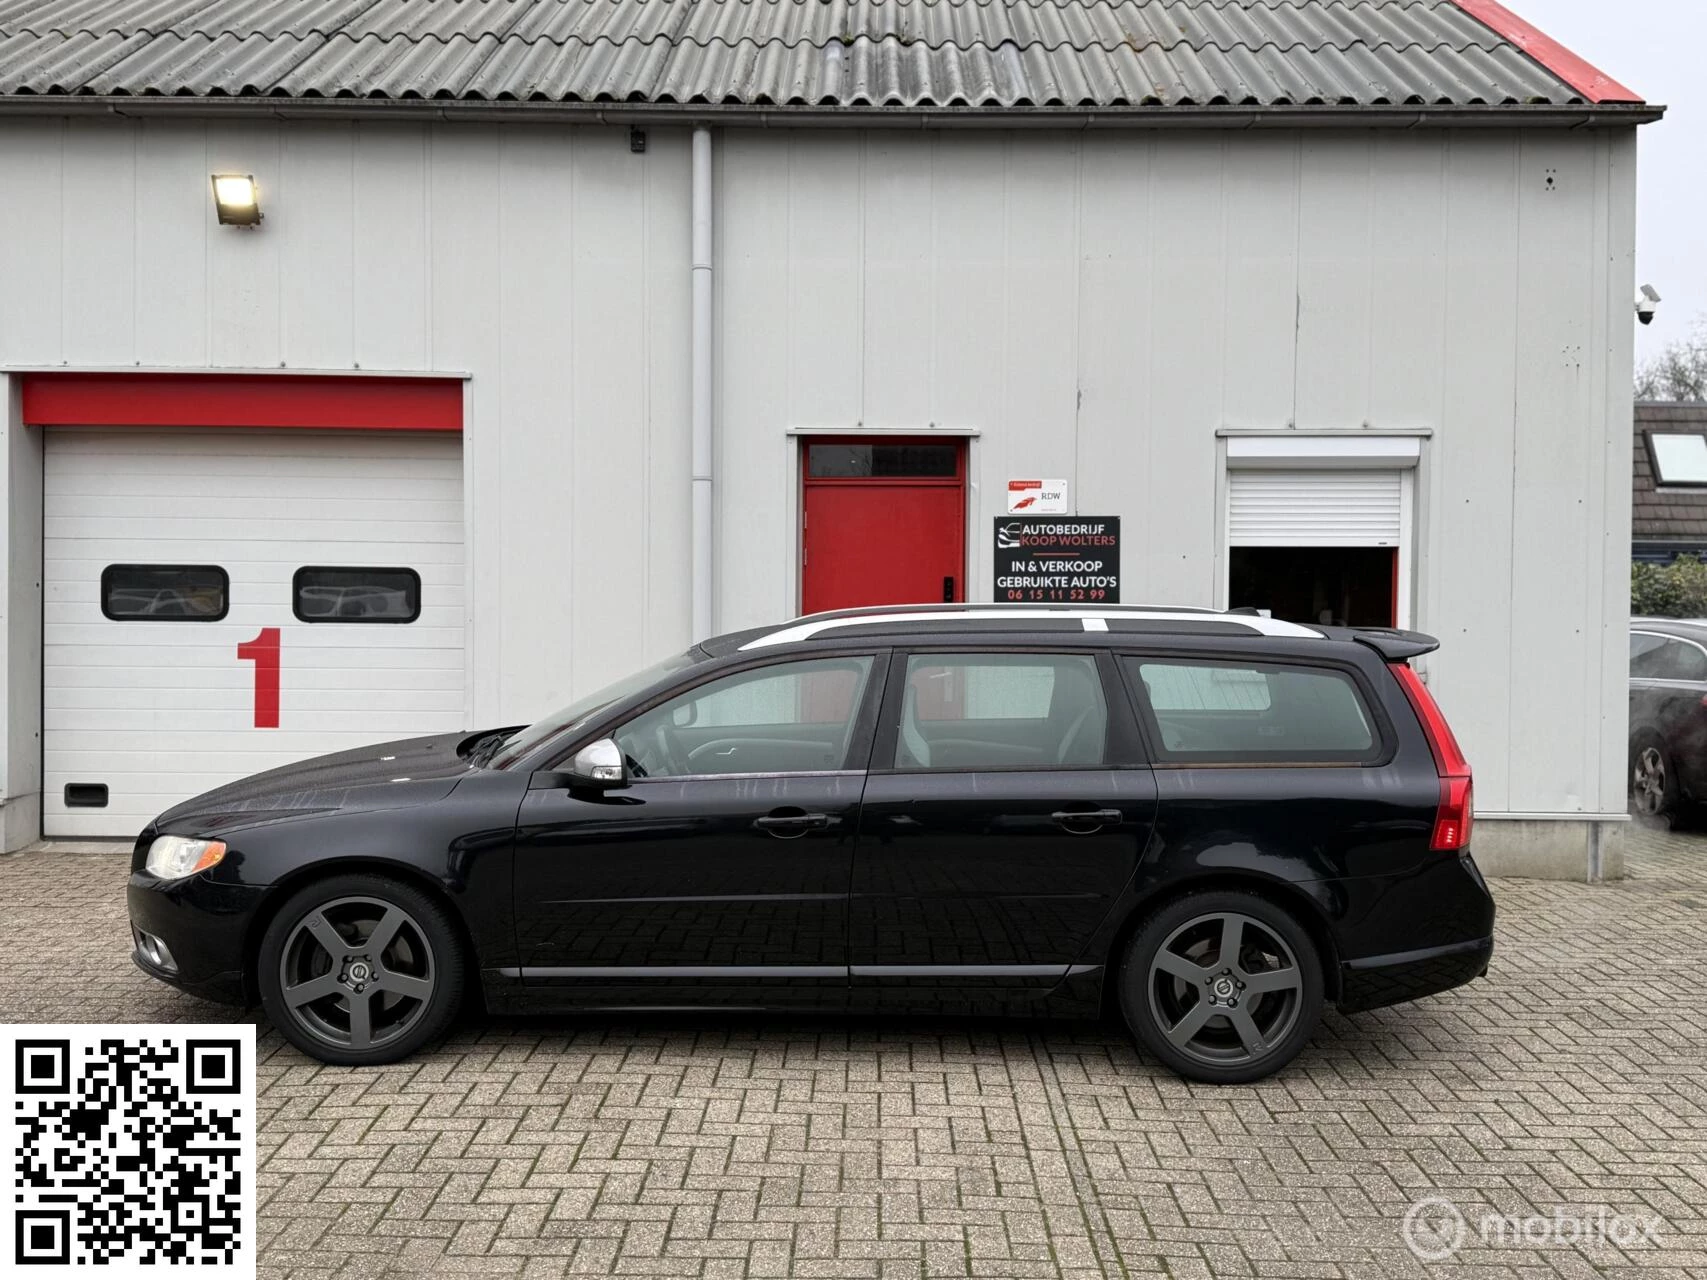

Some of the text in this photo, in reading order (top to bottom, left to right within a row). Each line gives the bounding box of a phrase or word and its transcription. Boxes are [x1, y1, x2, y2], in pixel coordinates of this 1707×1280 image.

[1041, 492, 1061, 500] RDW
[1022, 524, 1105, 535] AUTOBEDRIJF
[1022, 535, 1116, 546] KOOP WOLTERS
[1011, 561, 1103, 572] IN & VERKOOP
[997, 576, 1117, 588] GEBRUIKTE AUTO'S
[1007, 590, 1105, 600] 06 15 11 52 99
[237, 628, 280, 728] 1
